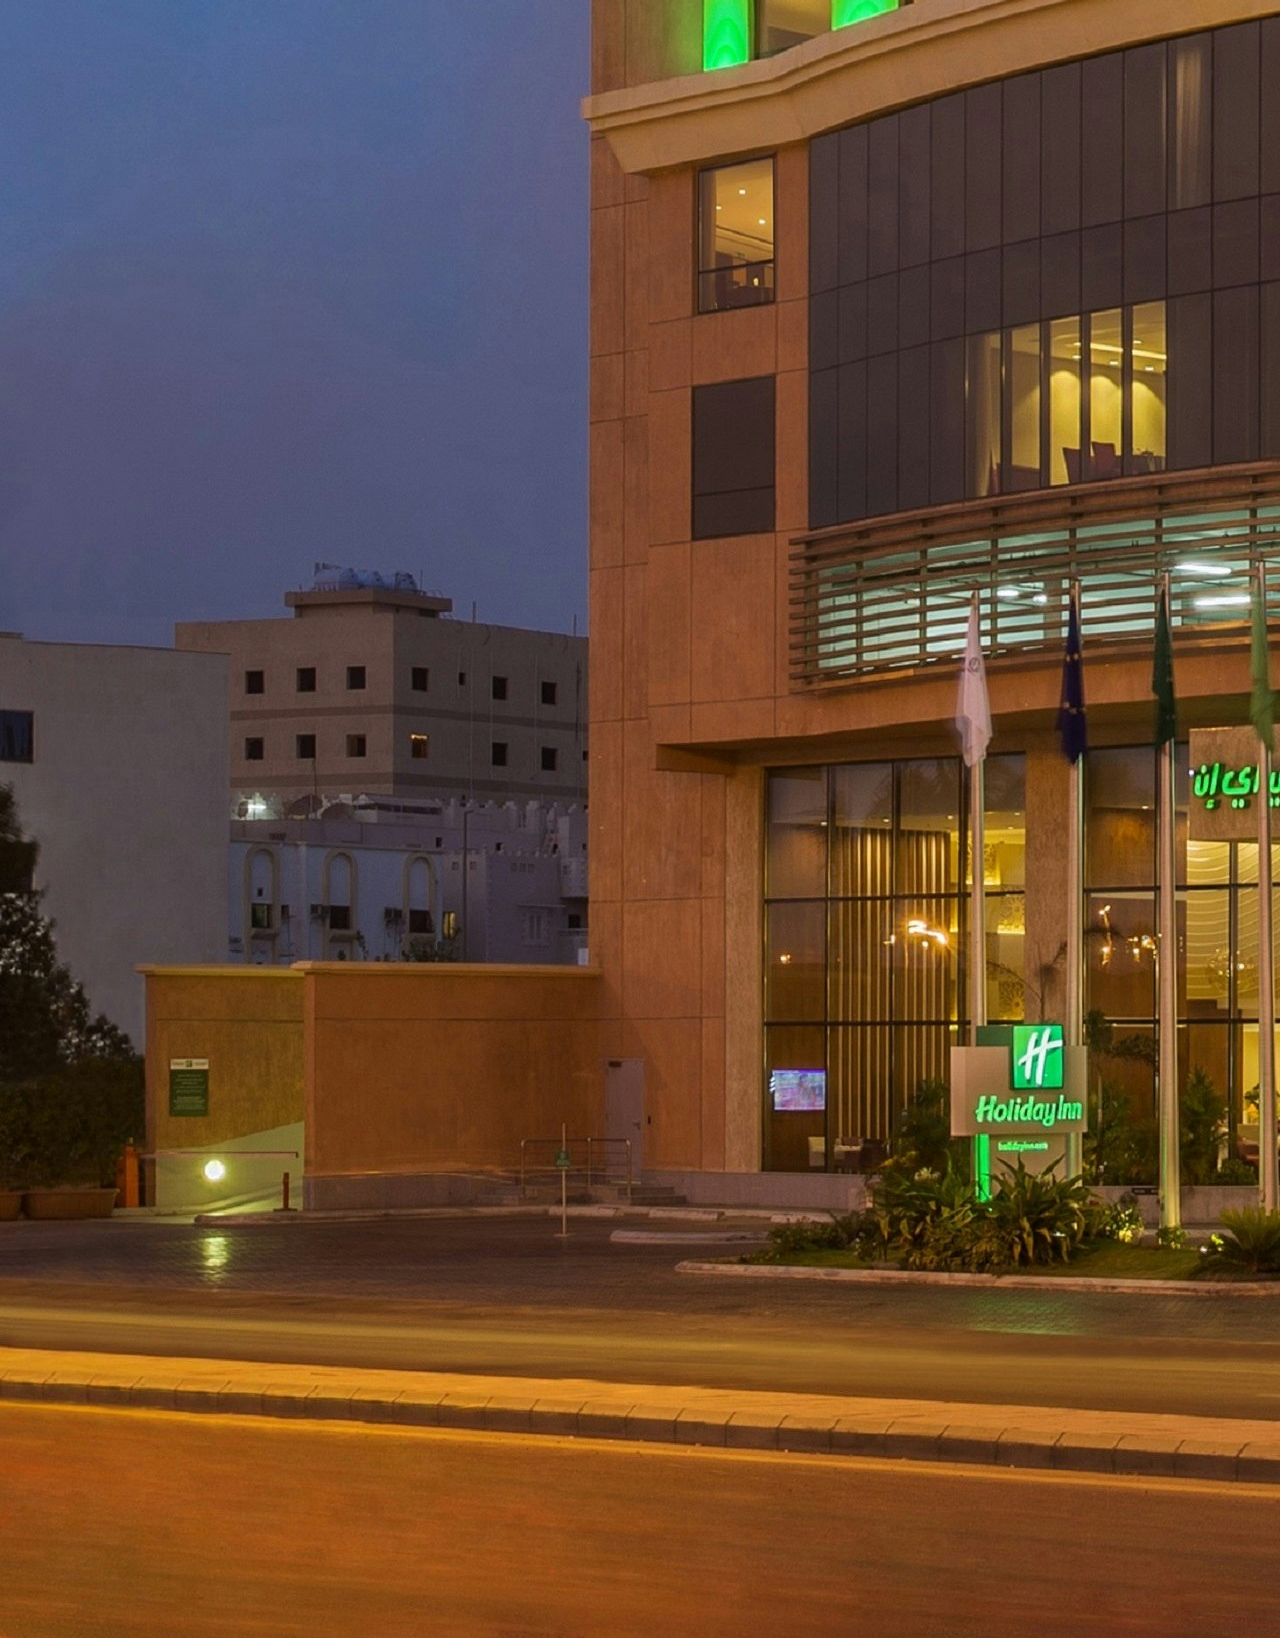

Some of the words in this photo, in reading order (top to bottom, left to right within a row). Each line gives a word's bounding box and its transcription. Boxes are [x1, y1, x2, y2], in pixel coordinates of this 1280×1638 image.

[1193, 762, 1221, 810] إن
[975, 1094, 1057, 1127] Holiday
[1056, 1094, 1083, 1121] Inn
